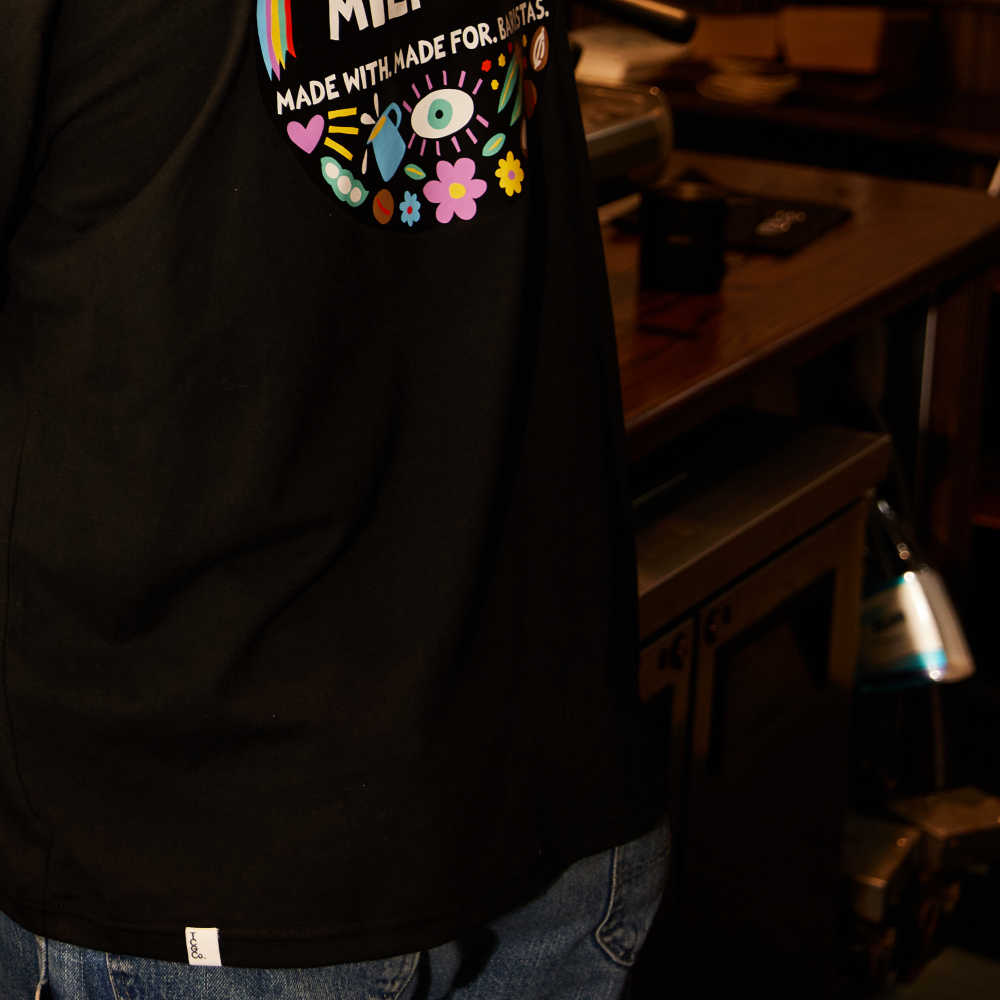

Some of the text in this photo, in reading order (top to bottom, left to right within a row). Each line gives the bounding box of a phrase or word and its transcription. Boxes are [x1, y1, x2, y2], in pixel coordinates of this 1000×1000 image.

[276, 73, 340, 115] MADE
[342, 55, 392, 94] WITH.
[394, 34, 446, 74] MADE
[450, 22, 498, 55] FOR.
